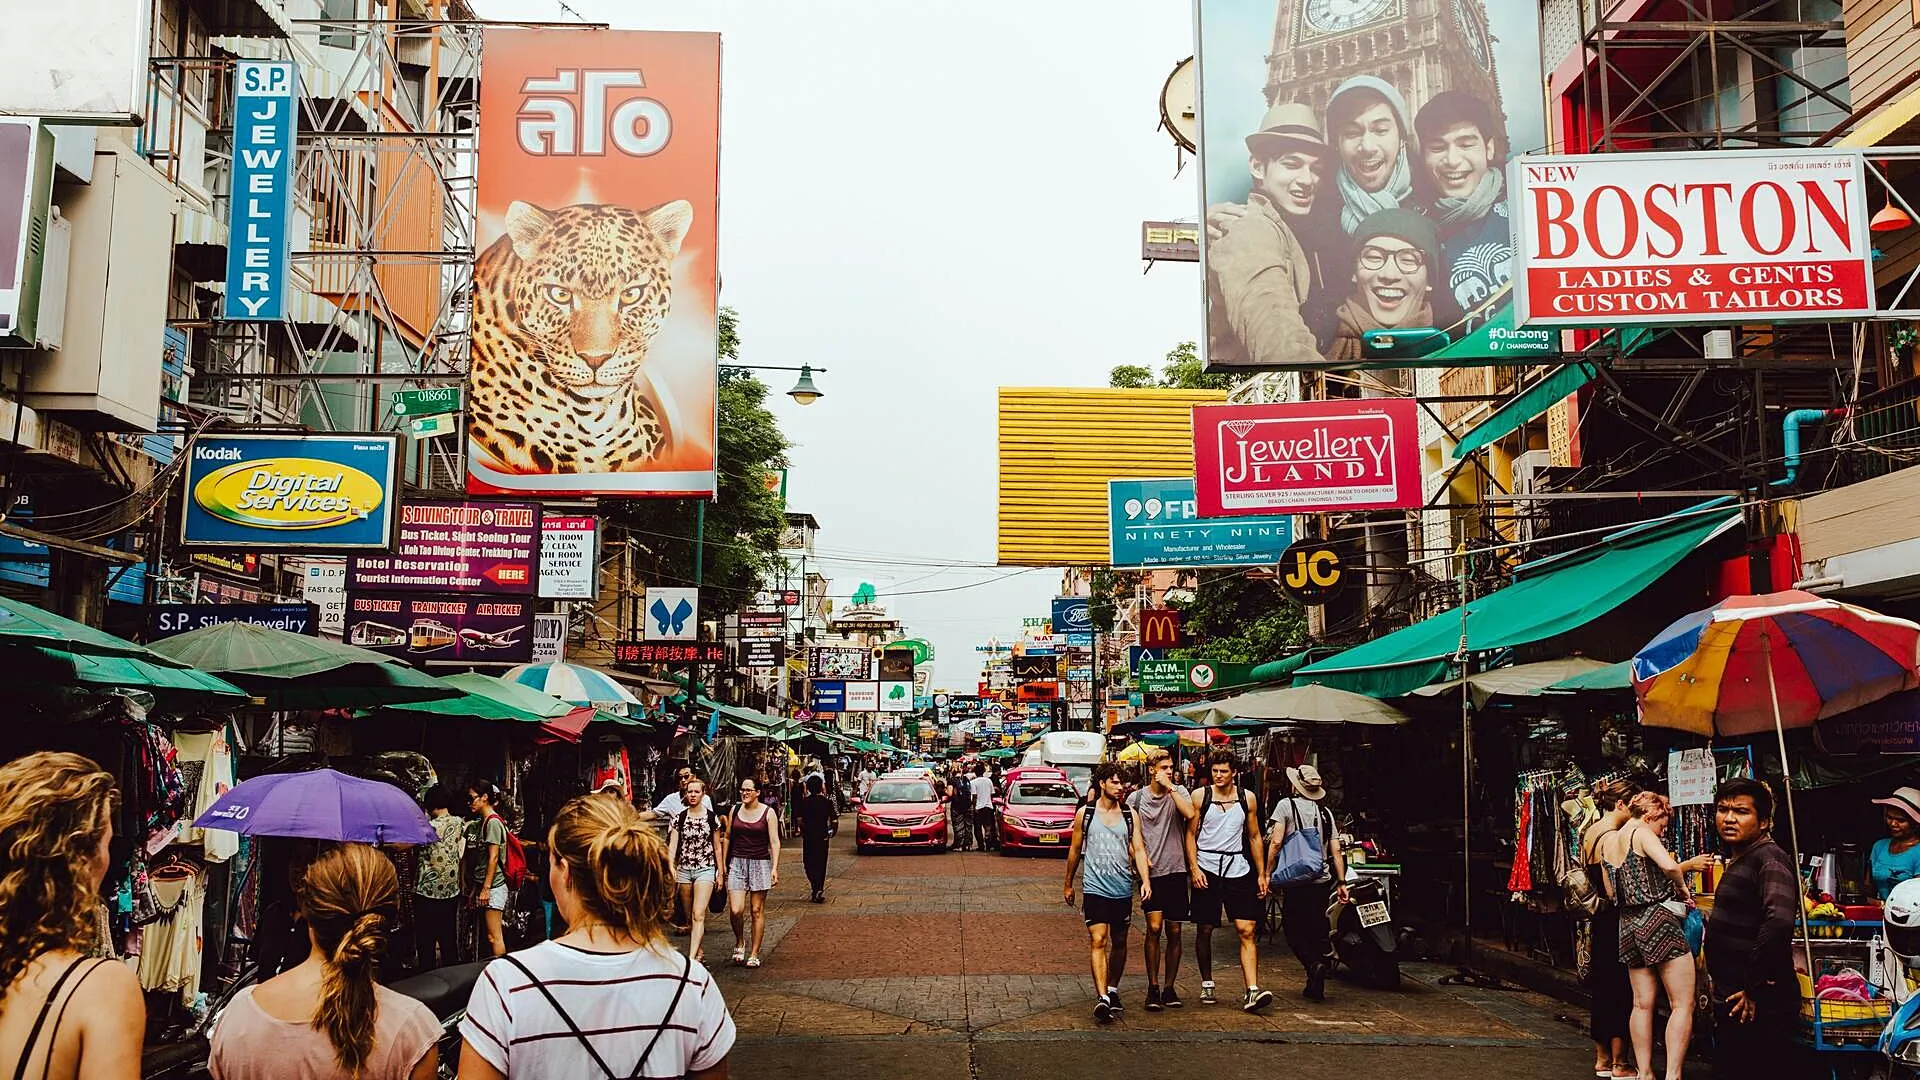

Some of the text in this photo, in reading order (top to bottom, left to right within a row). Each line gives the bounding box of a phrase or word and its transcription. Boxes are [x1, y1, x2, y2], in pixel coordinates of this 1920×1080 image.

[245, 67, 287, 92] S.P.
[516, 68, 673, 157] ลีโอ
[1528, 166, 1580, 183] NEW
[239, 101, 282, 316] JEWELLERY
[1528, 179, 1853, 259] BOSTON
[1557, 265, 1834, 288] LADIES & GENTS
[1552, 288, 1844, 313] CUSTOM TAILORS
[392, 392, 404, 404] 01
[418, 389, 452, 402] 018661
[195, 446, 242, 460] Kodak
[1253, 463, 1365, 483] LAND
[247, 470, 343, 496] Digital
[236, 491, 351, 512] Services
[1225, 492, 1255, 500] STERLING
[1277, 490, 1289, 498] 925
[413, 507, 450, 524] DIVING
[451, 508, 480, 525] TOUR
[495, 509, 533, 527] TRAVEL
[401, 530, 419, 539] Bus
[452, 531, 476, 542] Sight
[477, 532, 509, 543] Seeing
[510, 533, 532, 543] Tour
[1126, 527, 1286, 540] NINETY NINE
[404, 545, 418, 554] Koh
[419, 545, 432, 555] Tao
[432, 545, 455, 557] Diving
[481, 547, 512, 558] Trekking
[513, 548, 530, 558] Tour
[1163, 545, 1199, 553] Manufacturer
[1215, 543, 1246, 551] Wholesaler
[322, 569, 337, 577] I.D.
[356, 558, 469, 572] Hotel Reservation
[1285, 550, 1341, 589] JC
[355, 574, 482, 586] Tourist Information Center
[498, 569, 525, 580] HERE
[354, 600, 522, 616] BUS TICKET TRAIN TICKET AIR TICKET
[159, 613, 194, 630] S.P.
[325, 613, 340, 622] 20
[1155, 663, 1178, 673] ATM
